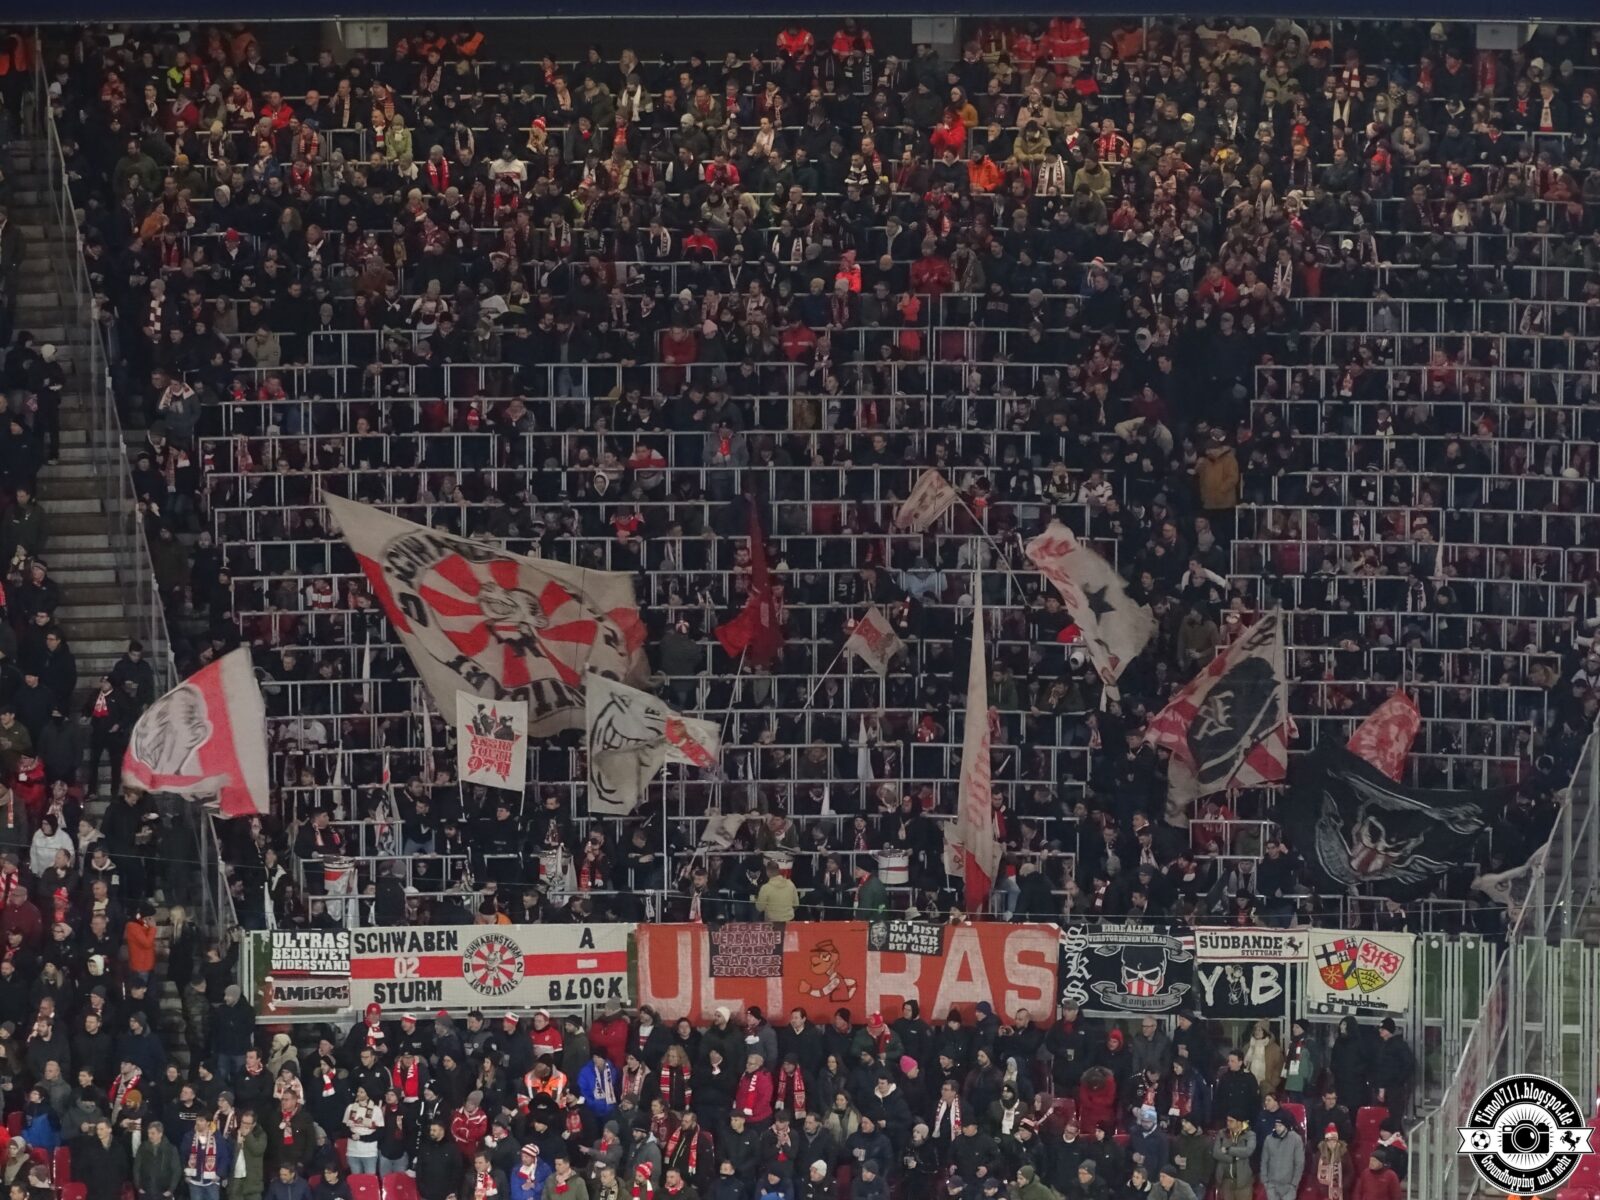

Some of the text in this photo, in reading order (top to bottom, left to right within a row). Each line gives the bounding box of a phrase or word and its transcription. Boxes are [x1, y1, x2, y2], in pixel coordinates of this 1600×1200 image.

[890, 923, 940, 935] DU BIST
[1102, 924, 1154, 933] EHRE ALLEN
[272, 932, 349, 948] ULTRAS
[354, 930, 458, 953] SCHWABEN
[579, 927, 595, 948] A
[712, 932, 781, 945] VERBANNTE
[889, 933, 939, 945] IMMER
[1200, 933, 1283, 950] SÜDBANDE
[272, 949, 349, 960] BEDEUTET
[464, 934, 521, 959] SCHWABENSTURM
[889, 942, 939, 954] BEI UNS!
[271, 960, 350, 971] WIDERSTAND
[394, 957, 420, 978] 02
[374, 980, 442, 1004] STURM
[549, 977, 622, 1000] BLOCK
